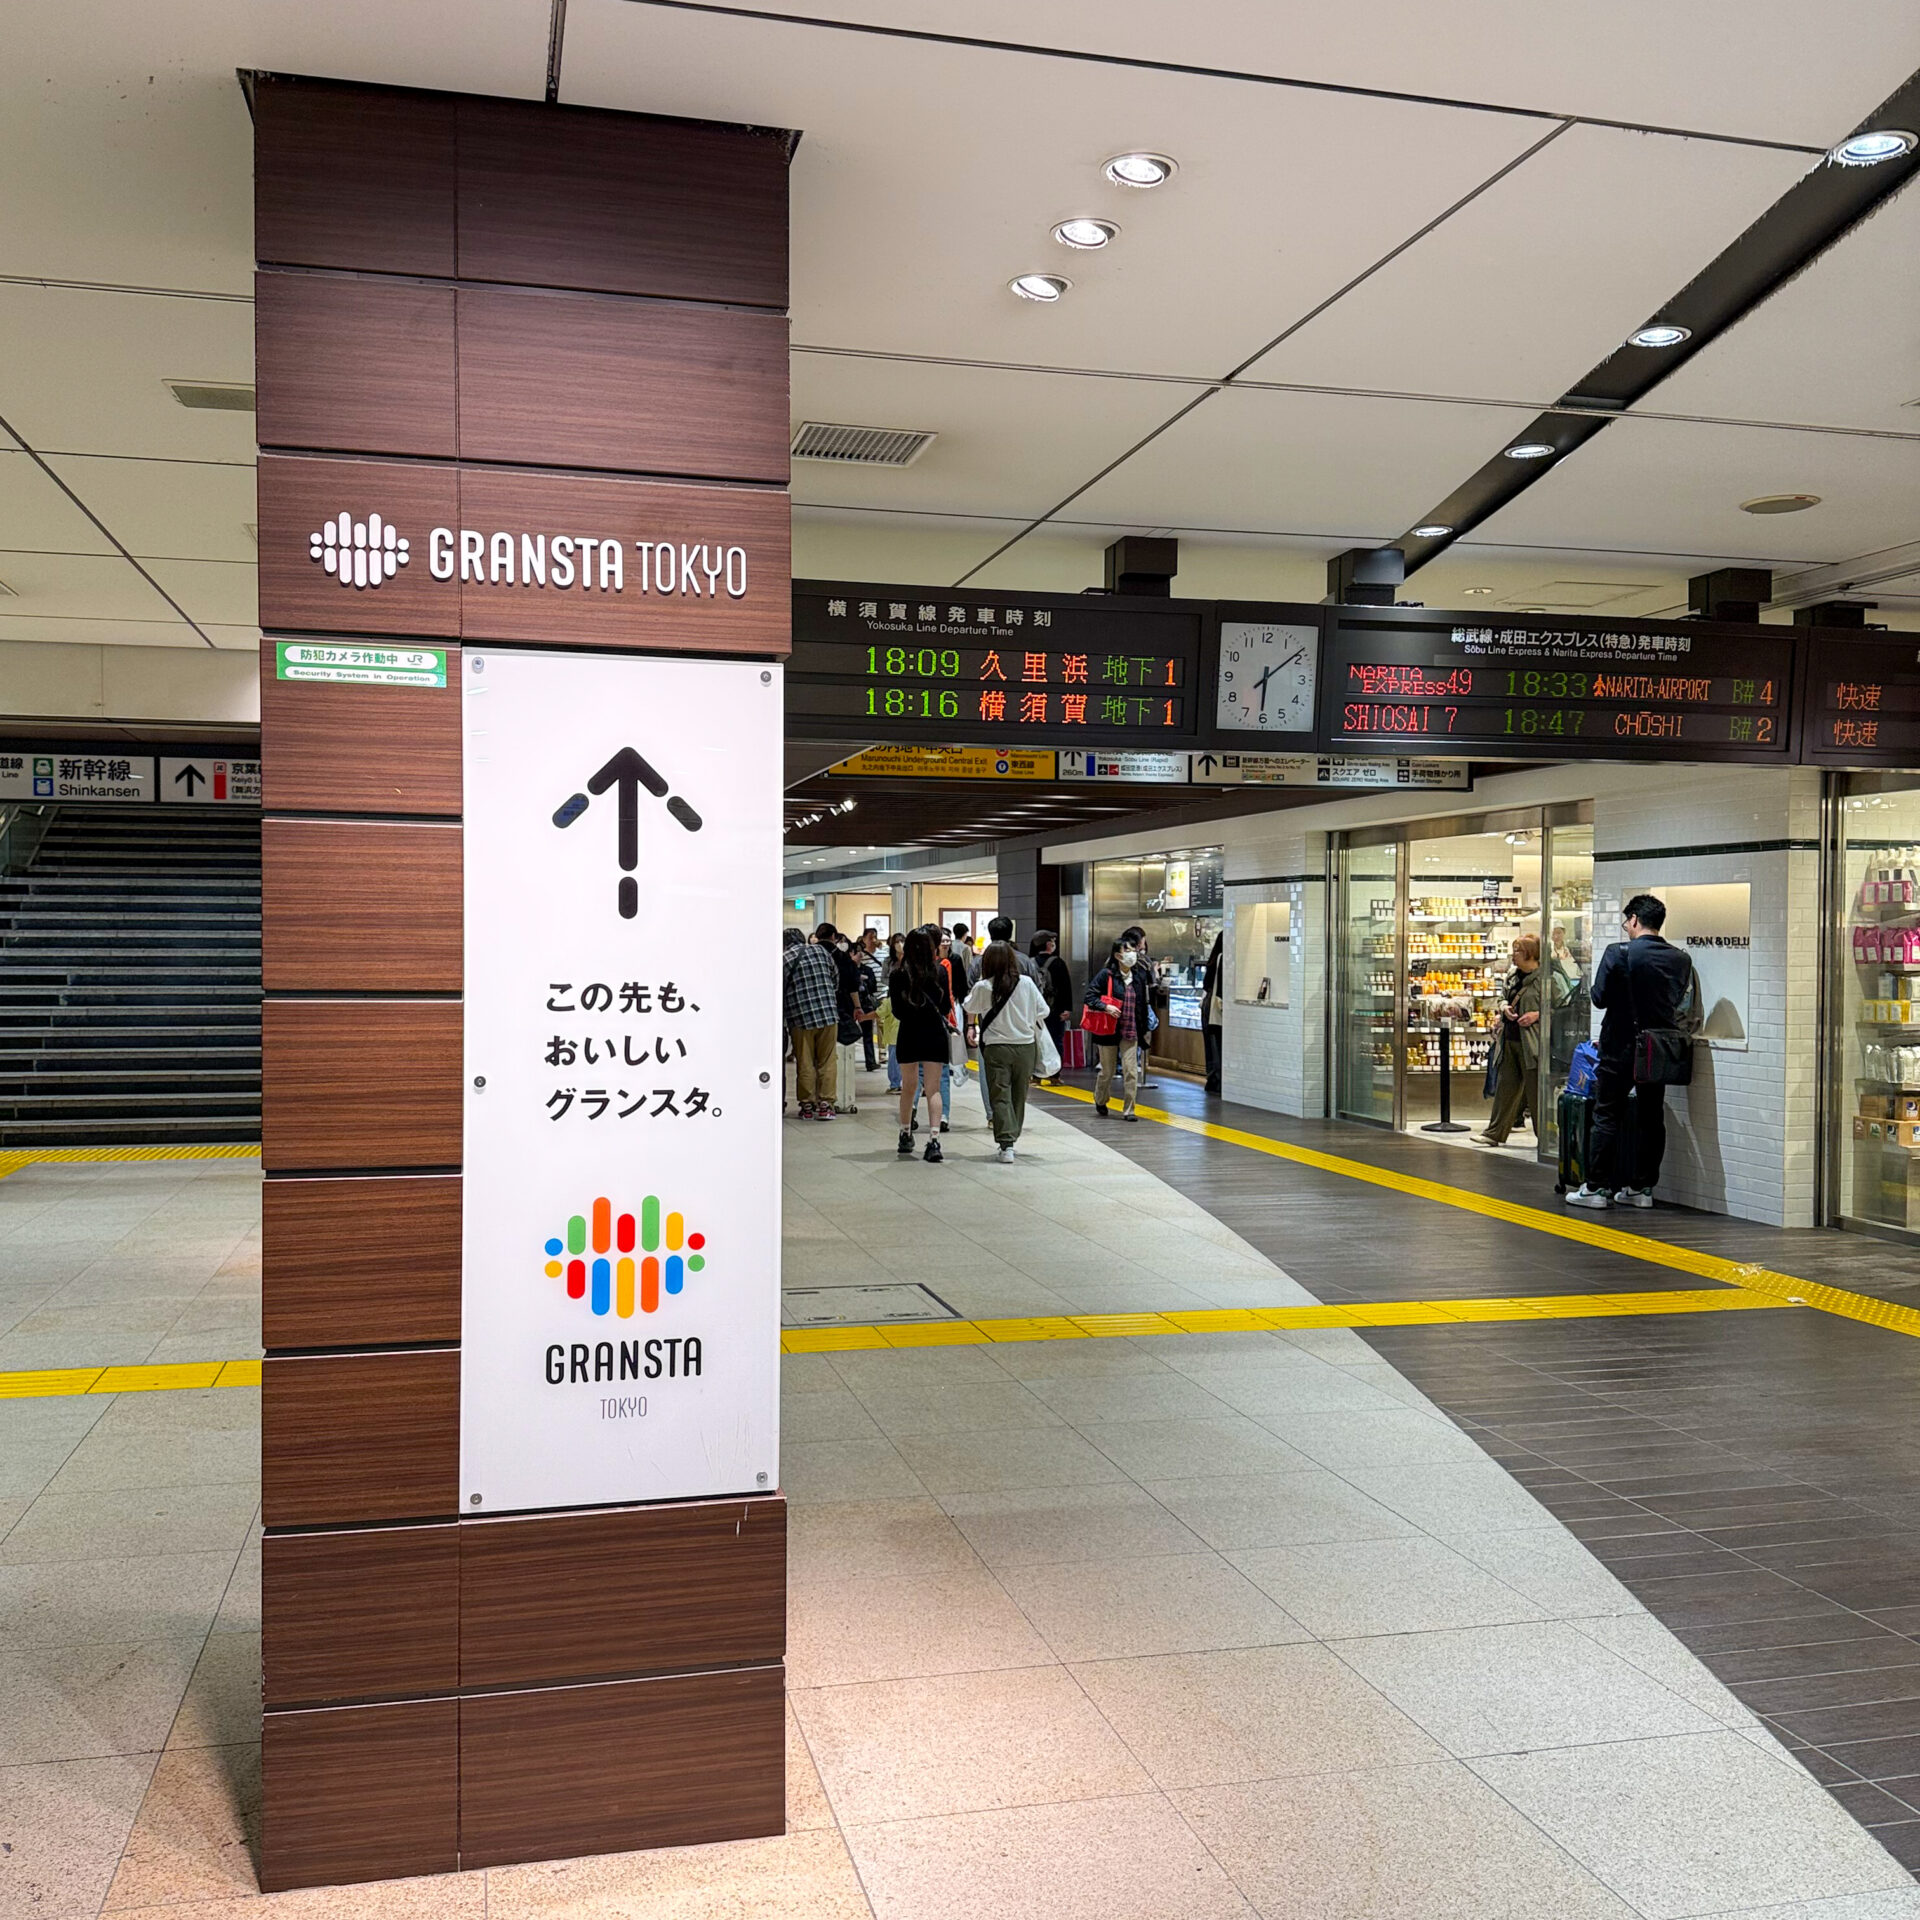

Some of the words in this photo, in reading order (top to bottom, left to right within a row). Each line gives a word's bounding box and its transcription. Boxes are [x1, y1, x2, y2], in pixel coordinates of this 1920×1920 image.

[429, 526, 624, 592] GRANSTA
[635, 540, 748, 598] TOKYO
[827, 598, 1052, 627] 横須賀線発車時刻
[866, 620, 914, 632] Yokosuka
[916, 624, 938, 633] Line
[939, 624, 988, 636] Departure
[990, 626, 1014, 636] Time
[1245, 637, 1254, 648] 11
[1261, 632, 1274, 644] 12
[300, 648, 398, 665] 防犯カメラ作動中
[407, 654, 424, 664] JR
[1229, 651, 1240, 662] 10
[1294, 653, 1303, 665] 2
[1488, 646, 1507, 655] Line
[1508, 646, 1542, 657] Express
[1544, 647, 1550, 657] &
[1552, 647, 1579, 658] Narita
[1580, 649, 1613, 660] Express
[1614, 650, 1656, 662] Departure
[1658, 652, 1678, 662] Time
[866, 646, 960, 677] 18:09
[979, 649, 1089, 684] 久里浜
[1101, 655, 1156, 686] 地下
[1164, 658, 1177, 686] 1
[293, 669, 332, 679] Security
[336, 671, 369, 680] System
[386, 674, 431, 682] Operation
[1224, 671, 1234, 682] 9
[1297, 674, 1306, 685] 3
[1349, 665, 1423, 680] NARITA
[1447, 668, 1473, 695] 49
[1505, 670, 1588, 698] 18:33
[1605, 675, 1712, 701] NARITA-AIRPORT
[1759, 680, 1774, 705] 4
[1361, 680, 1448, 696] EXPRESS
[1228, 691, 1237, 703] 8
[1291, 694, 1299, 705] 4
[1836, 682, 1882, 711] 快速
[865, 687, 959, 718] 18:16
[979, 690, 1088, 724] 横須賀
[1101, 695, 1155, 726] 地下
[1163, 698, 1175, 726] 1
[1241, 706, 1250, 717] 7
[1278, 708, 1286, 719] 5
[1258, 713, 1268, 724] 6
[1343, 704, 1430, 732] SHIOSAI
[1445, 706, 1458, 733] 7
[1503, 708, 1585, 735] 18:47
[1615, 711, 1684, 737] CHŌSHI
[1756, 717, 1772, 742] 2
[1833, 719, 1879, 747] 快速
[861, 753, 901, 763] Marunouchi
[903, 755, 947, 765] Underground
[948, 757, 973, 765] Central
[59, 759, 131, 781] 新幹線
[1332, 768, 1360, 776] スクエア
[1363, 769, 1377, 777] ゼロ
[59, 784, 140, 797] Shinkansen
[1686, 936, 1713, 946] DEAN
[1715, 936, 1723, 946] &
[546, 981, 701, 1014] この先も、
[544, 1035, 687, 1067] おいしい
[545, 1087, 722, 1122] グランスタ。
[545, 1336, 702, 1385] GRANSTA
[600, 1396, 648, 1420] TOKYO
